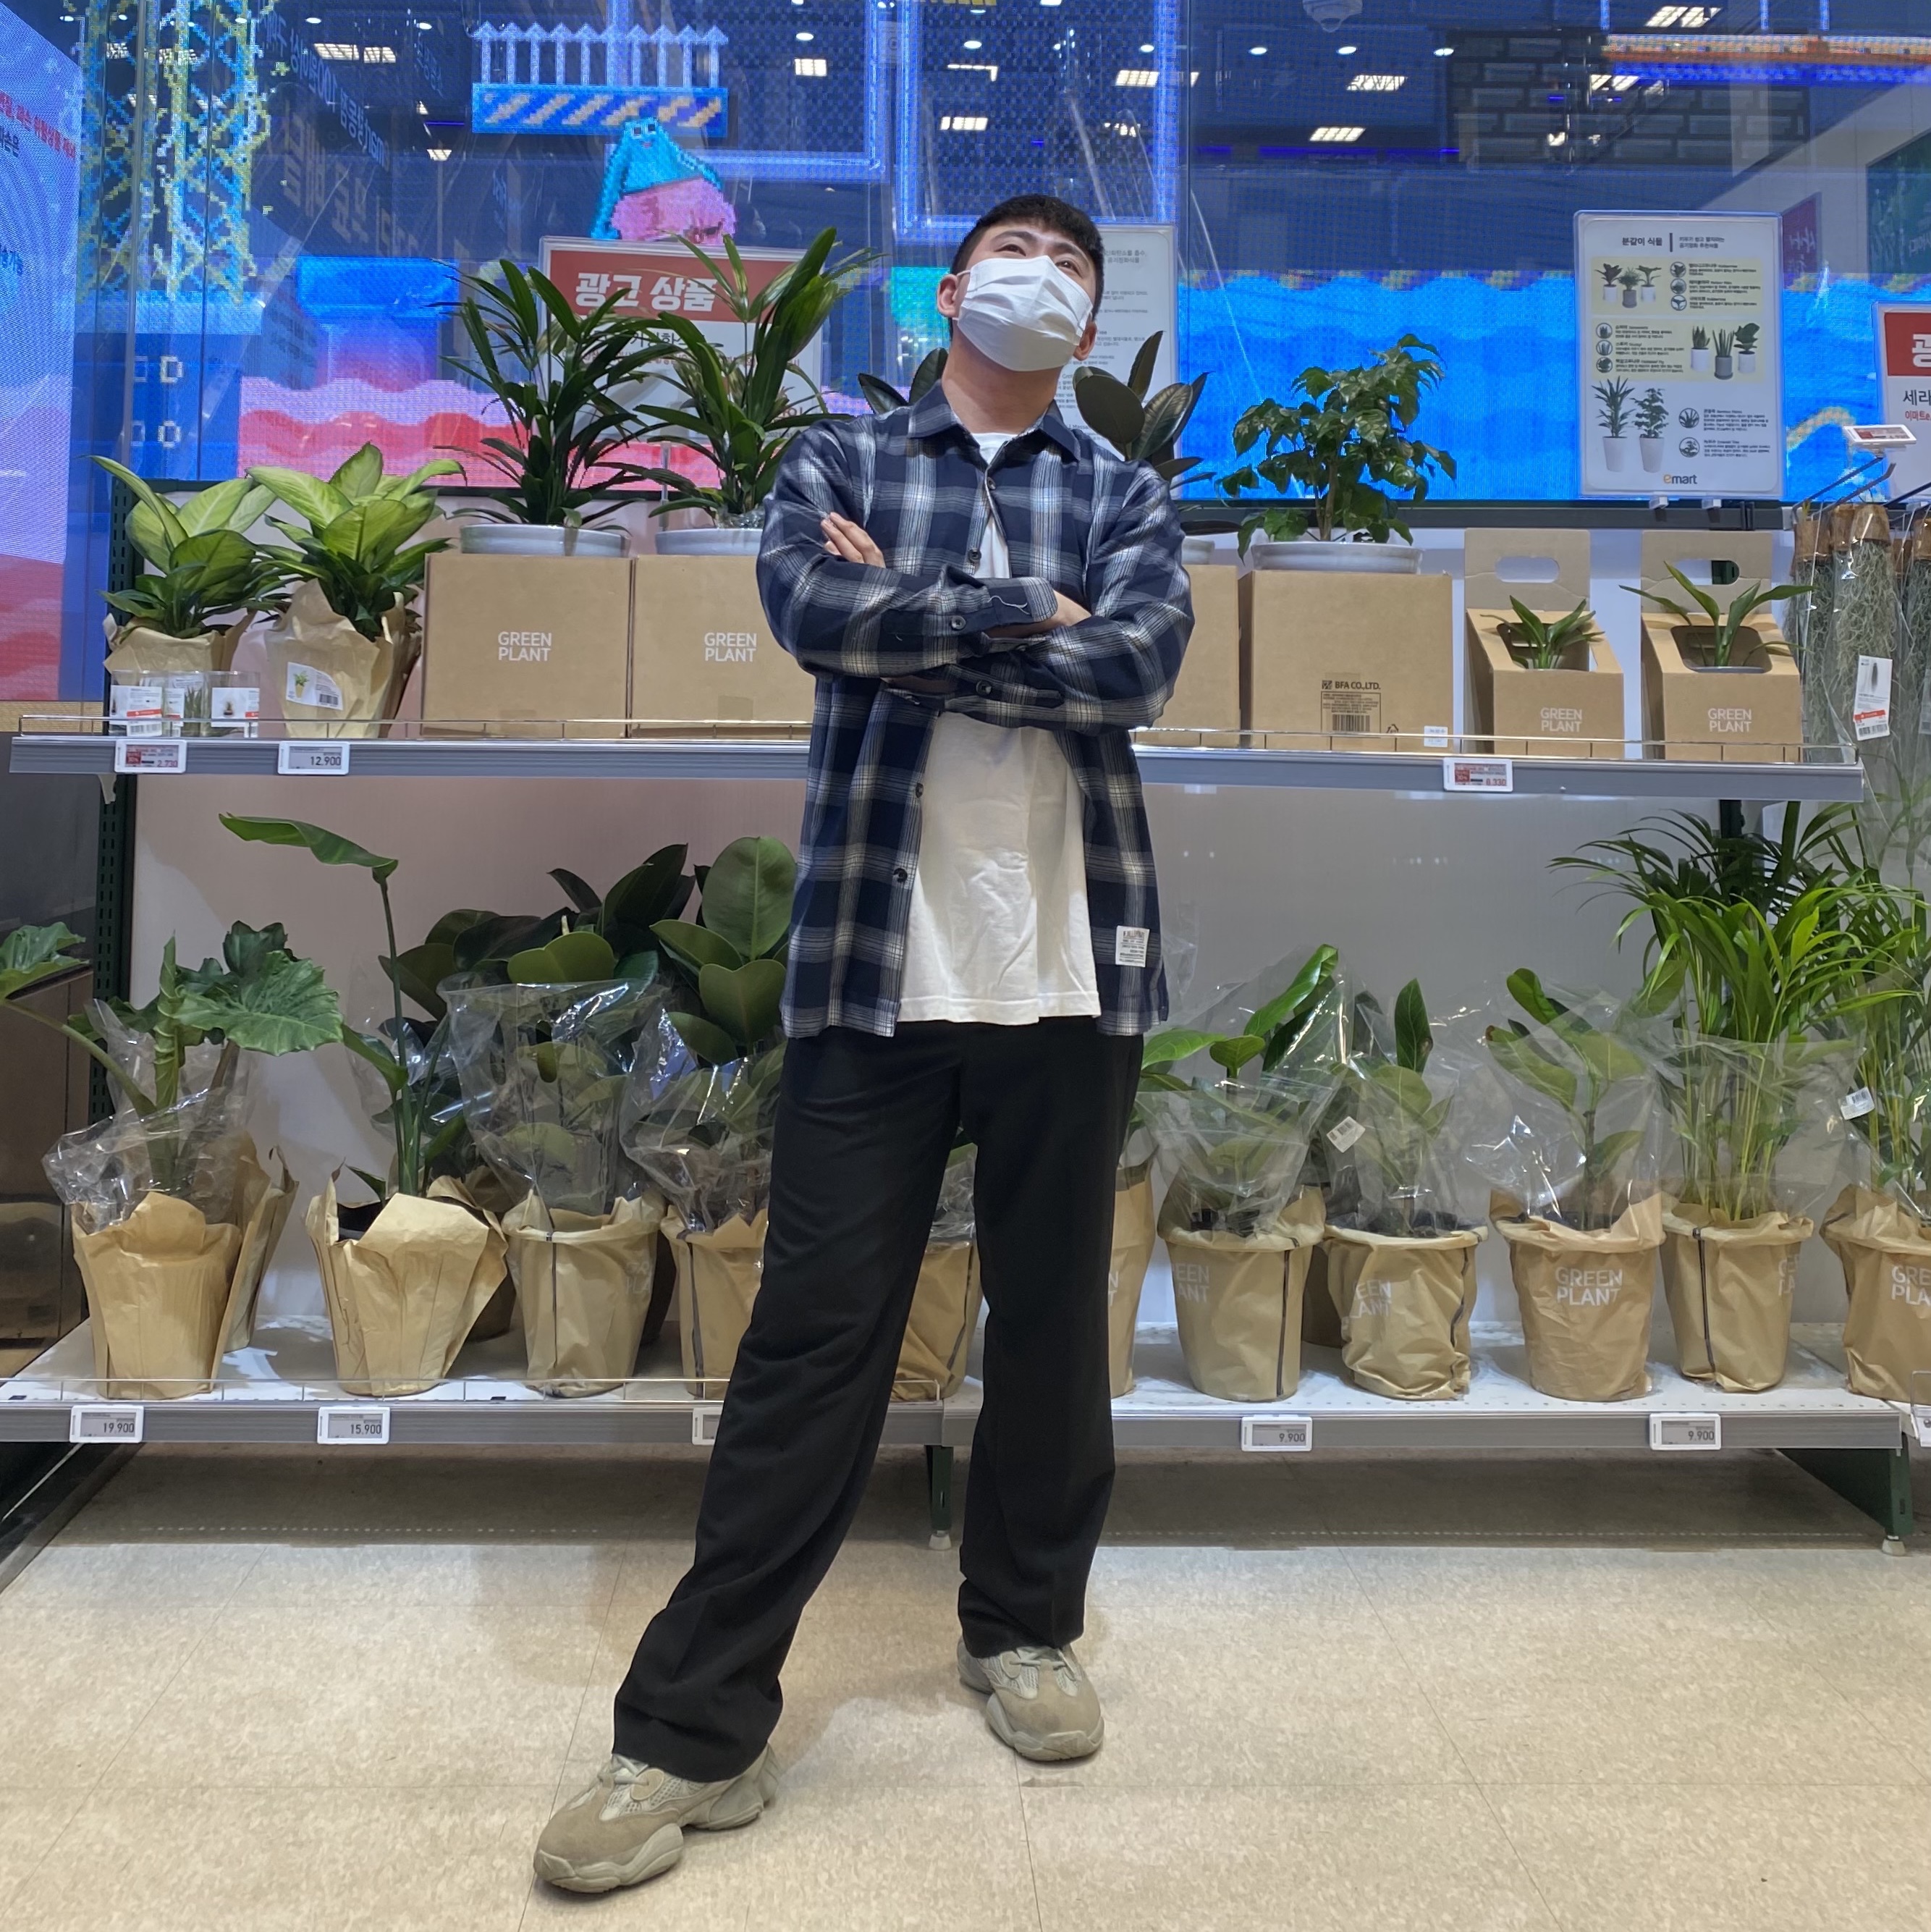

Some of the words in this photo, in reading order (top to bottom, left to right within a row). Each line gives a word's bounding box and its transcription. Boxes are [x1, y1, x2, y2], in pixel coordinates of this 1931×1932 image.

[575, 272, 641, 307] 광고
[651, 276, 718, 312] 상품
[1663, 473, 1698, 484] emart
[498, 631, 552, 646] GREEN
[704, 632, 757, 647] GREEN
[498, 646, 552, 662] PLANT
[705, 647, 756, 662] PLANT
[1540, 707, 1582, 720] GREEN
[1708, 708, 1752, 720] GREEN
[1541, 720, 1582, 733] PLANT
[1709, 720, 1752, 733] PLANT
[1555, 1266, 1623, 1287] GREEN
[1556, 1286, 1622, 1307] PLANT
